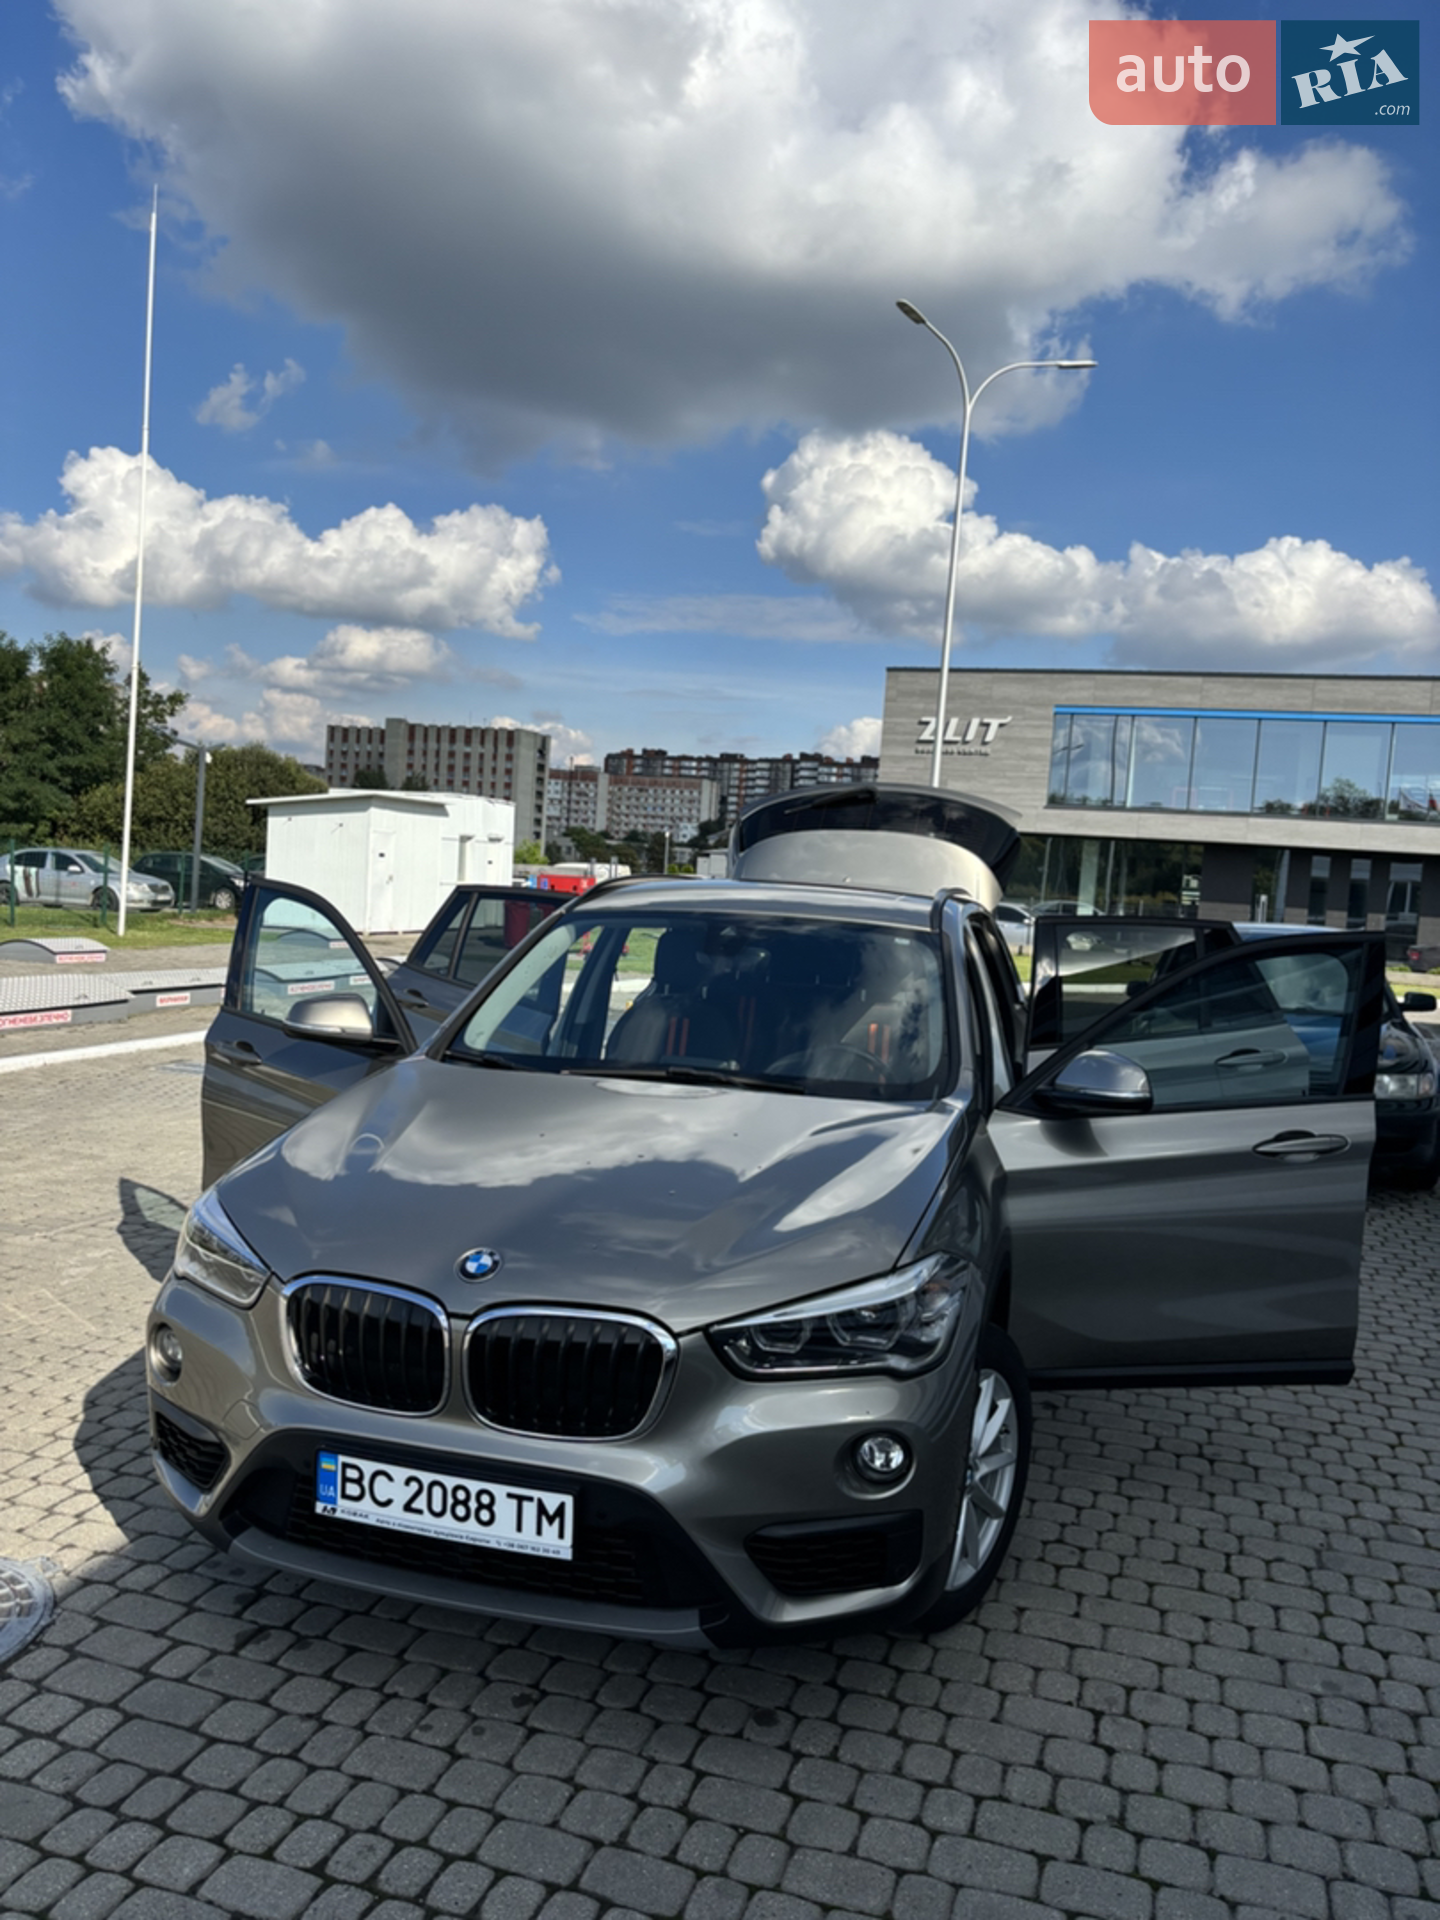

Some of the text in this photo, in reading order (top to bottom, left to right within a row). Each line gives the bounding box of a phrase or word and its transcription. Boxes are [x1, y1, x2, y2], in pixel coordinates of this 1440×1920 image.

[917, 716, 1013, 743] ZLIT
[319, 1484, 336, 1499] UA
[340, 1462, 567, 1540] BC 2088 TM
